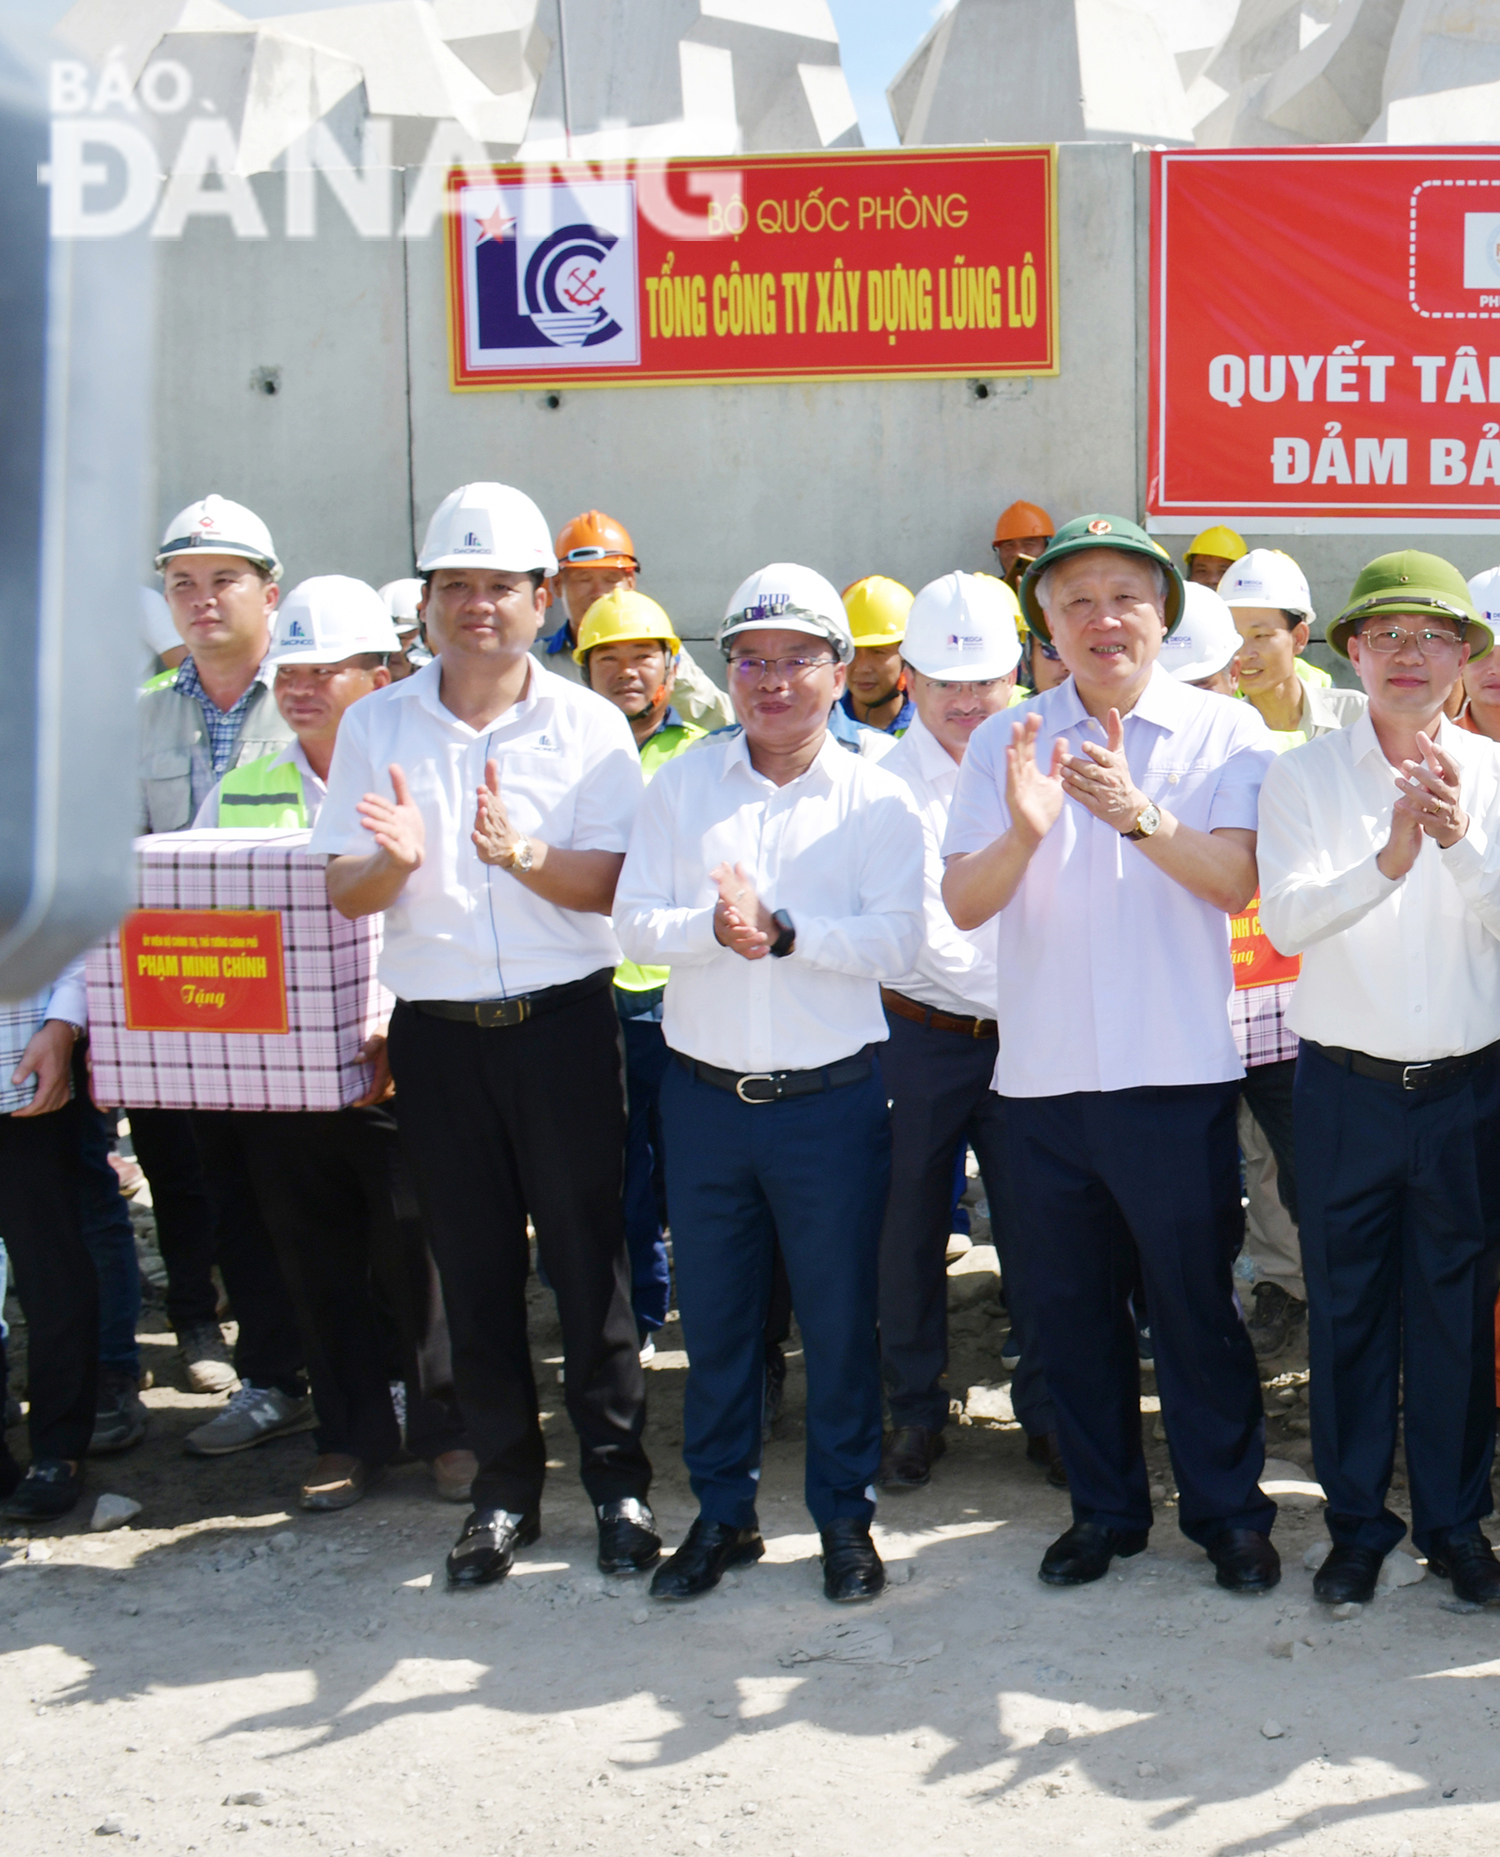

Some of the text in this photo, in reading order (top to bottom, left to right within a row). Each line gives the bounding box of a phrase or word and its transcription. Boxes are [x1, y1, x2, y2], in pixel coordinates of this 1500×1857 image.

[707, 186, 969, 242] BỘ QUỐC PHÒNG
[645, 250, 1037, 346] TỔNG CÔNG TY XÂY DỰNG LŨNG LÔ
[1208, 340, 1395, 408] QUYẾT
[1270, 421, 1408, 485] ĐẢM
[137, 952, 267, 981] PHẠM MINH CHÍNH
